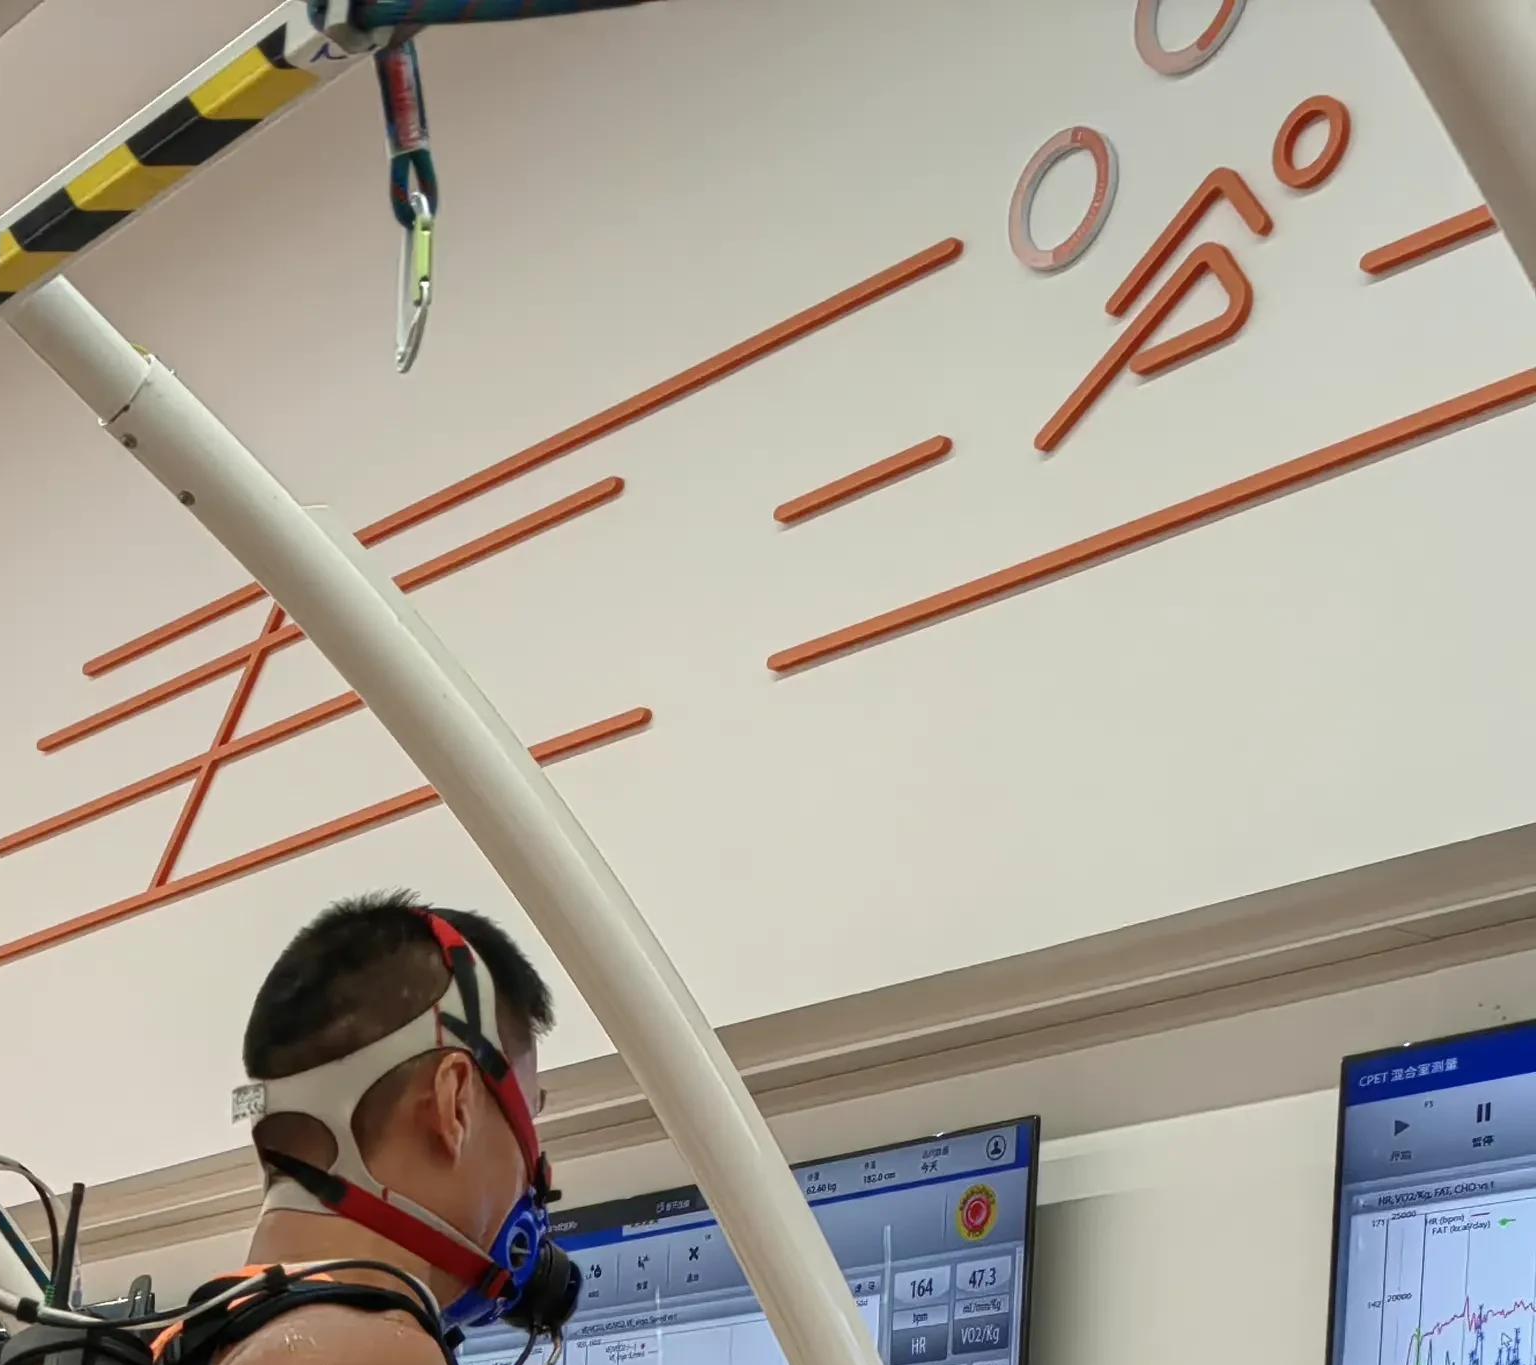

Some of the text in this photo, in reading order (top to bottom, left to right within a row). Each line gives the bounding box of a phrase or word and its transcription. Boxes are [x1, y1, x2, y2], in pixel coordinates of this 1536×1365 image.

[1359, 1057, 1459, 1087] CPET 混合室测量
[910, 1277, 934, 1299] 164
[968, 1266, 997, 1289] 47.3
[961, 1323, 1001, 1345] VO2/Kg
[911, 1336, 927, 1356] HR
